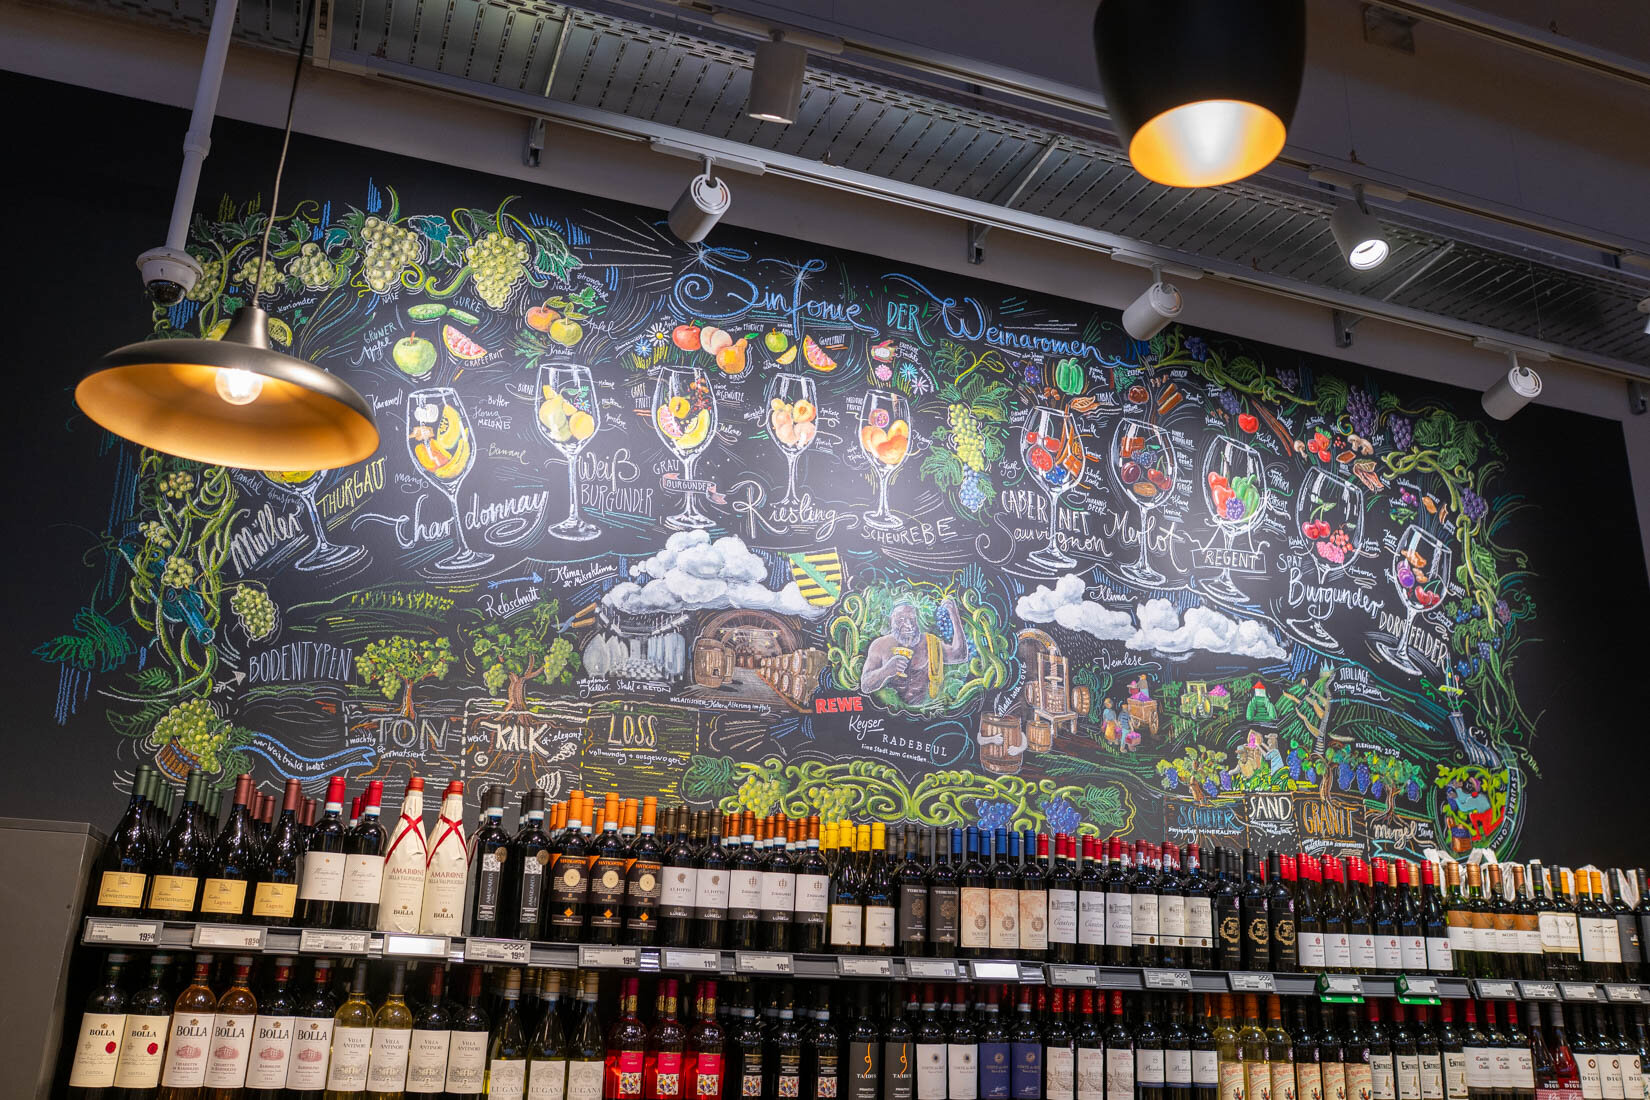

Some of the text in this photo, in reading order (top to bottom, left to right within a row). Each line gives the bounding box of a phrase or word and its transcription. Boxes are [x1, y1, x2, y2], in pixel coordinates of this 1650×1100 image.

[277, 297, 317, 313] Koriander
[453, 296, 482, 314] GURKE
[674, 241, 880, 342] Sinfonie
[887, 301, 933, 346] DER
[363, 322, 396, 344] GRÜNER
[581, 318, 617, 339] Apfel
[464, 349, 504, 368] GRAPEFRUIT
[366, 388, 403, 416] Karamell
[1096, 392, 1118, 405] TABAK
[478, 420, 511, 430] MELONE
[489, 443, 529, 464] Banane
[578, 448, 640, 491] Weiß
[653, 459, 680, 475] GRAU
[231, 468, 262, 495] Mandel
[316, 457, 386, 518] THURGAU
[666, 479, 713, 490] BURGUNDER
[581, 484, 653, 517] BURGUNDER
[726, 480, 859, 542] Riesling
[231, 502, 304, 578] Müller
[861, 517, 957, 545] SCHEUREBE
[1104, 509, 1188, 573] Merlot
[1204, 550, 1259, 570] REGENT
[548, 565, 581, 583] Klima
[574, 562, 618, 586] Mikroklima
[478, 586, 541, 618] Rebschnitt
[1085, 585, 1138, 602] Klima
[1289, 566, 1384, 620] Burgunder
[249, 641, 352, 683] BODENTYPEN
[1094, 648, 1161, 669] Weinlese
[998, 698, 1014, 718] Made
[1020, 662, 1028, 685] LOVE
[815, 697, 863, 714] REWE
[377, 718, 449, 751] TON
[607, 704, 658, 747] LÖSS
[849, 714, 884, 740] Keyser
[467, 732, 490, 743] weich
[480, 721, 549, 758] KALK
[861, 743, 873, 751] Eine
[873, 745, 888, 755] Stadt
[889, 750, 901, 758] zum
[882, 734, 947, 757] RADEBEUL
[589, 750, 627, 766] vollmundig
[1507, 776, 1518, 816] VERITAS
[1177, 805, 1245, 832] SCHIEFER
[1249, 797, 1293, 821] SAND
[1302, 801, 1359, 837] GRANIT
[1373, 821, 1437, 850] Mergel
[1491, 828, 1508, 850] VINO
[391, 868, 425, 876] AMARONE
[431, 871, 464, 880] AMARONE
[131, 1030, 157, 1038] BOLLA
[176, 1025, 207, 1037] BOLLA
[215, 1027, 245, 1038] BOLLA
[259, 1029, 289, 1040] BOLLA
[297, 1030, 327, 1041] BOLLA
